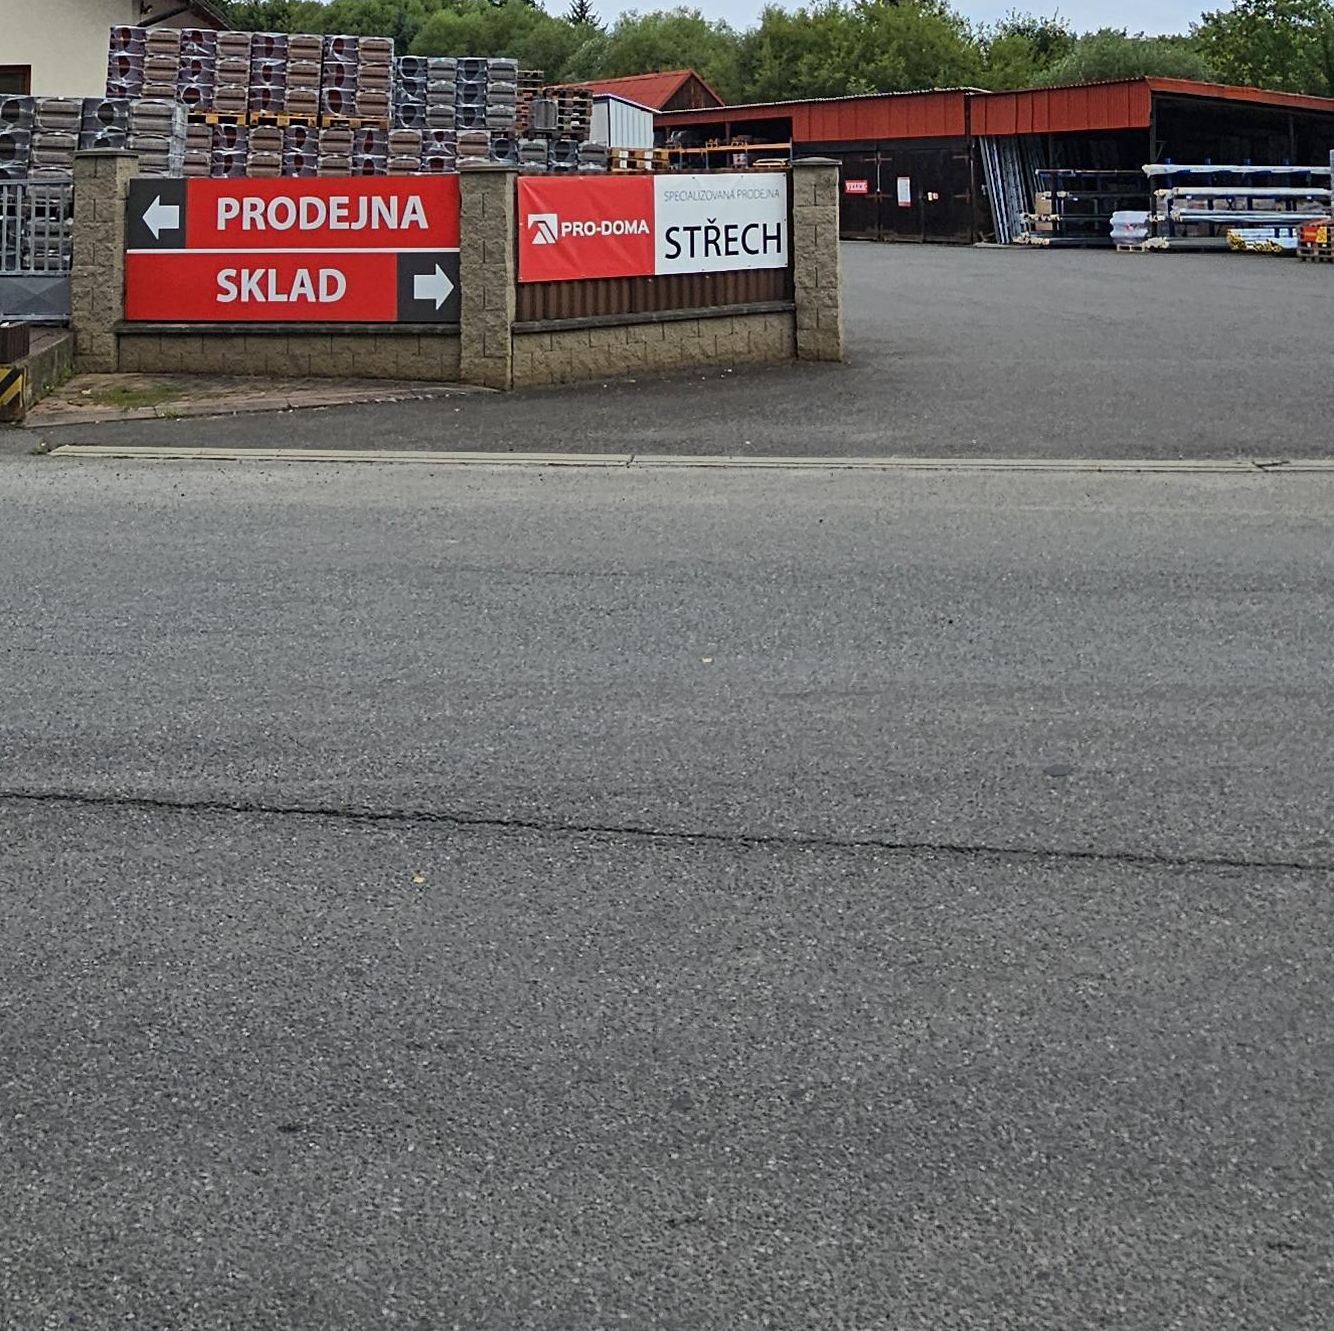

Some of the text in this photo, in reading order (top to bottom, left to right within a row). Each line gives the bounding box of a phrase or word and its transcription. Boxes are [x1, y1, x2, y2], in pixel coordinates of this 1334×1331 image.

[736, 187, 780, 200] PRODEJNA
[217, 195, 429, 231] PRODEJNA
[561, 219, 650, 238] PRO-DOMA
[664, 217, 782, 259] STŘECH
[217, 268, 347, 303] SKLAD
